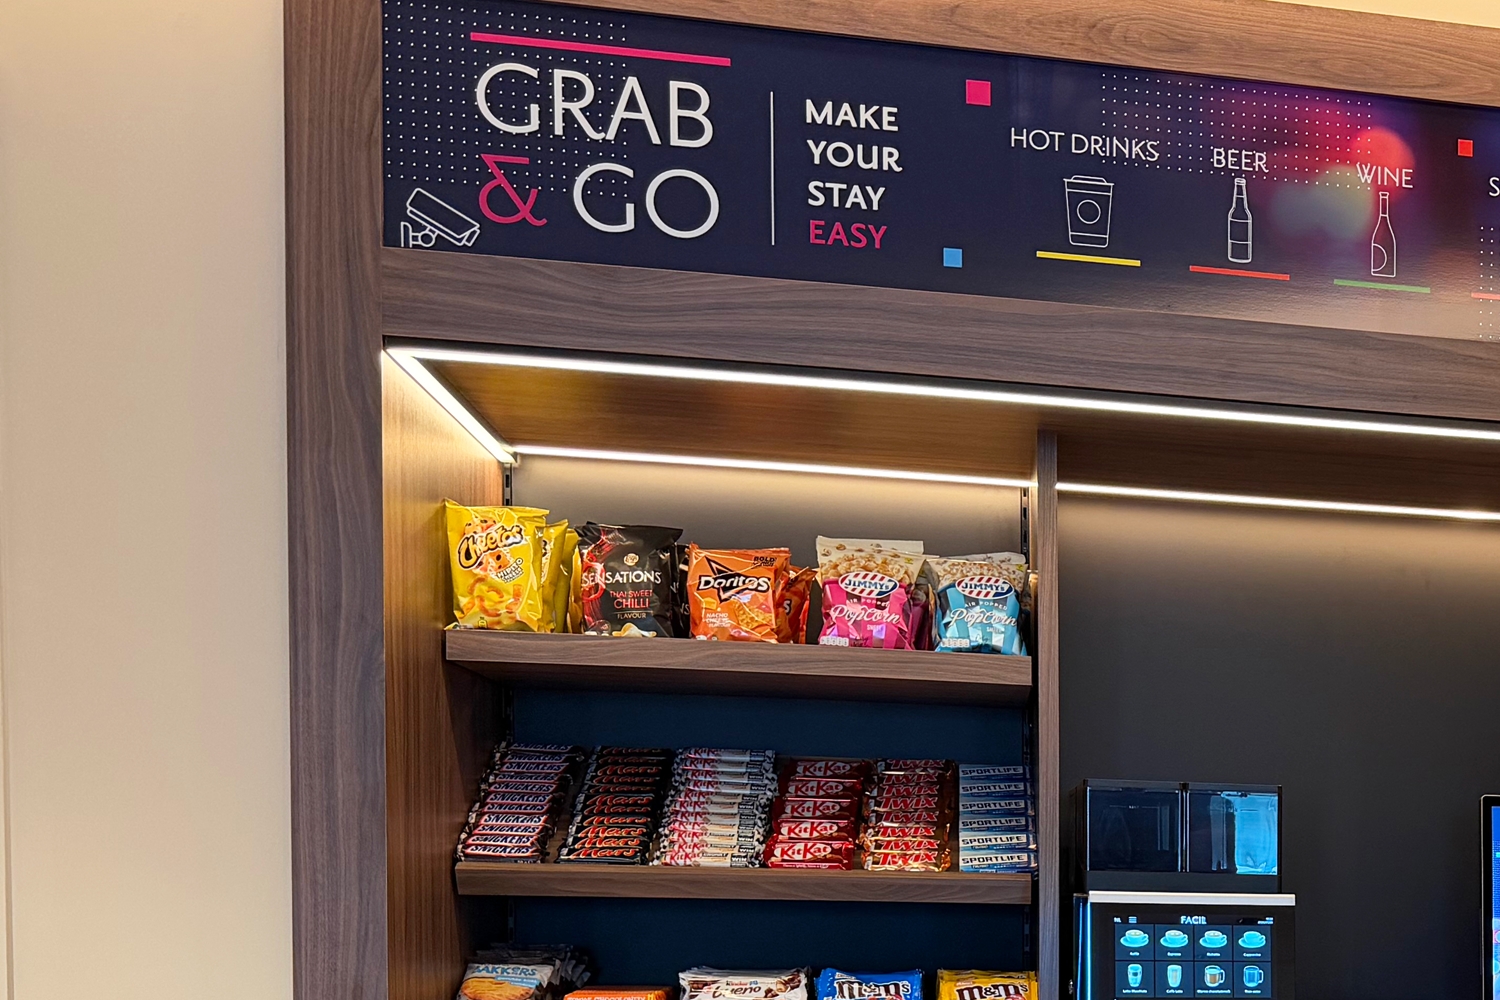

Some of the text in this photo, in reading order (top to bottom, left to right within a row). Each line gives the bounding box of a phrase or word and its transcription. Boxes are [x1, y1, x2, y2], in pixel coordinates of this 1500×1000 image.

[475, 62, 714, 148] GRAB
[805, 98, 899, 132] MAKE
[1011, 127, 1160, 163] HOT DRINKS
[806, 139, 903, 171] YOUR
[1213, 147, 1269, 174] BEER
[1356, 162, 1414, 189] WINE
[478, 153, 720, 239] & GO
[807, 180, 886, 211] STAY
[808, 220, 888, 249] EASY
[457, 524, 524, 570] Cheetos
[581, 571, 663, 587] SENSATIONS
[698, 575, 770, 593] Doritos
[610, 589, 652, 598] THAI SWEET
[614, 598, 649, 609] CHILLI
[617, 612, 646, 620] FLAVOUR
[961, 801, 1025, 810] SPORTLIFE
[484, 814, 547, 824] SNICKERS
[961, 818, 1026, 828] SPORTLIFE
[478, 825, 540, 834] SNICKERS
[579, 827, 646, 837] Mars
[471, 836, 536, 844] SNICKERS
[575, 837, 645, 848] Mars
[961, 835, 1027, 845] SPORTLIFE
[570, 848, 639, 859] Mars
[961, 854, 1027, 864] SPORTLIFE
[1180, 916, 1207, 924] FACIL
